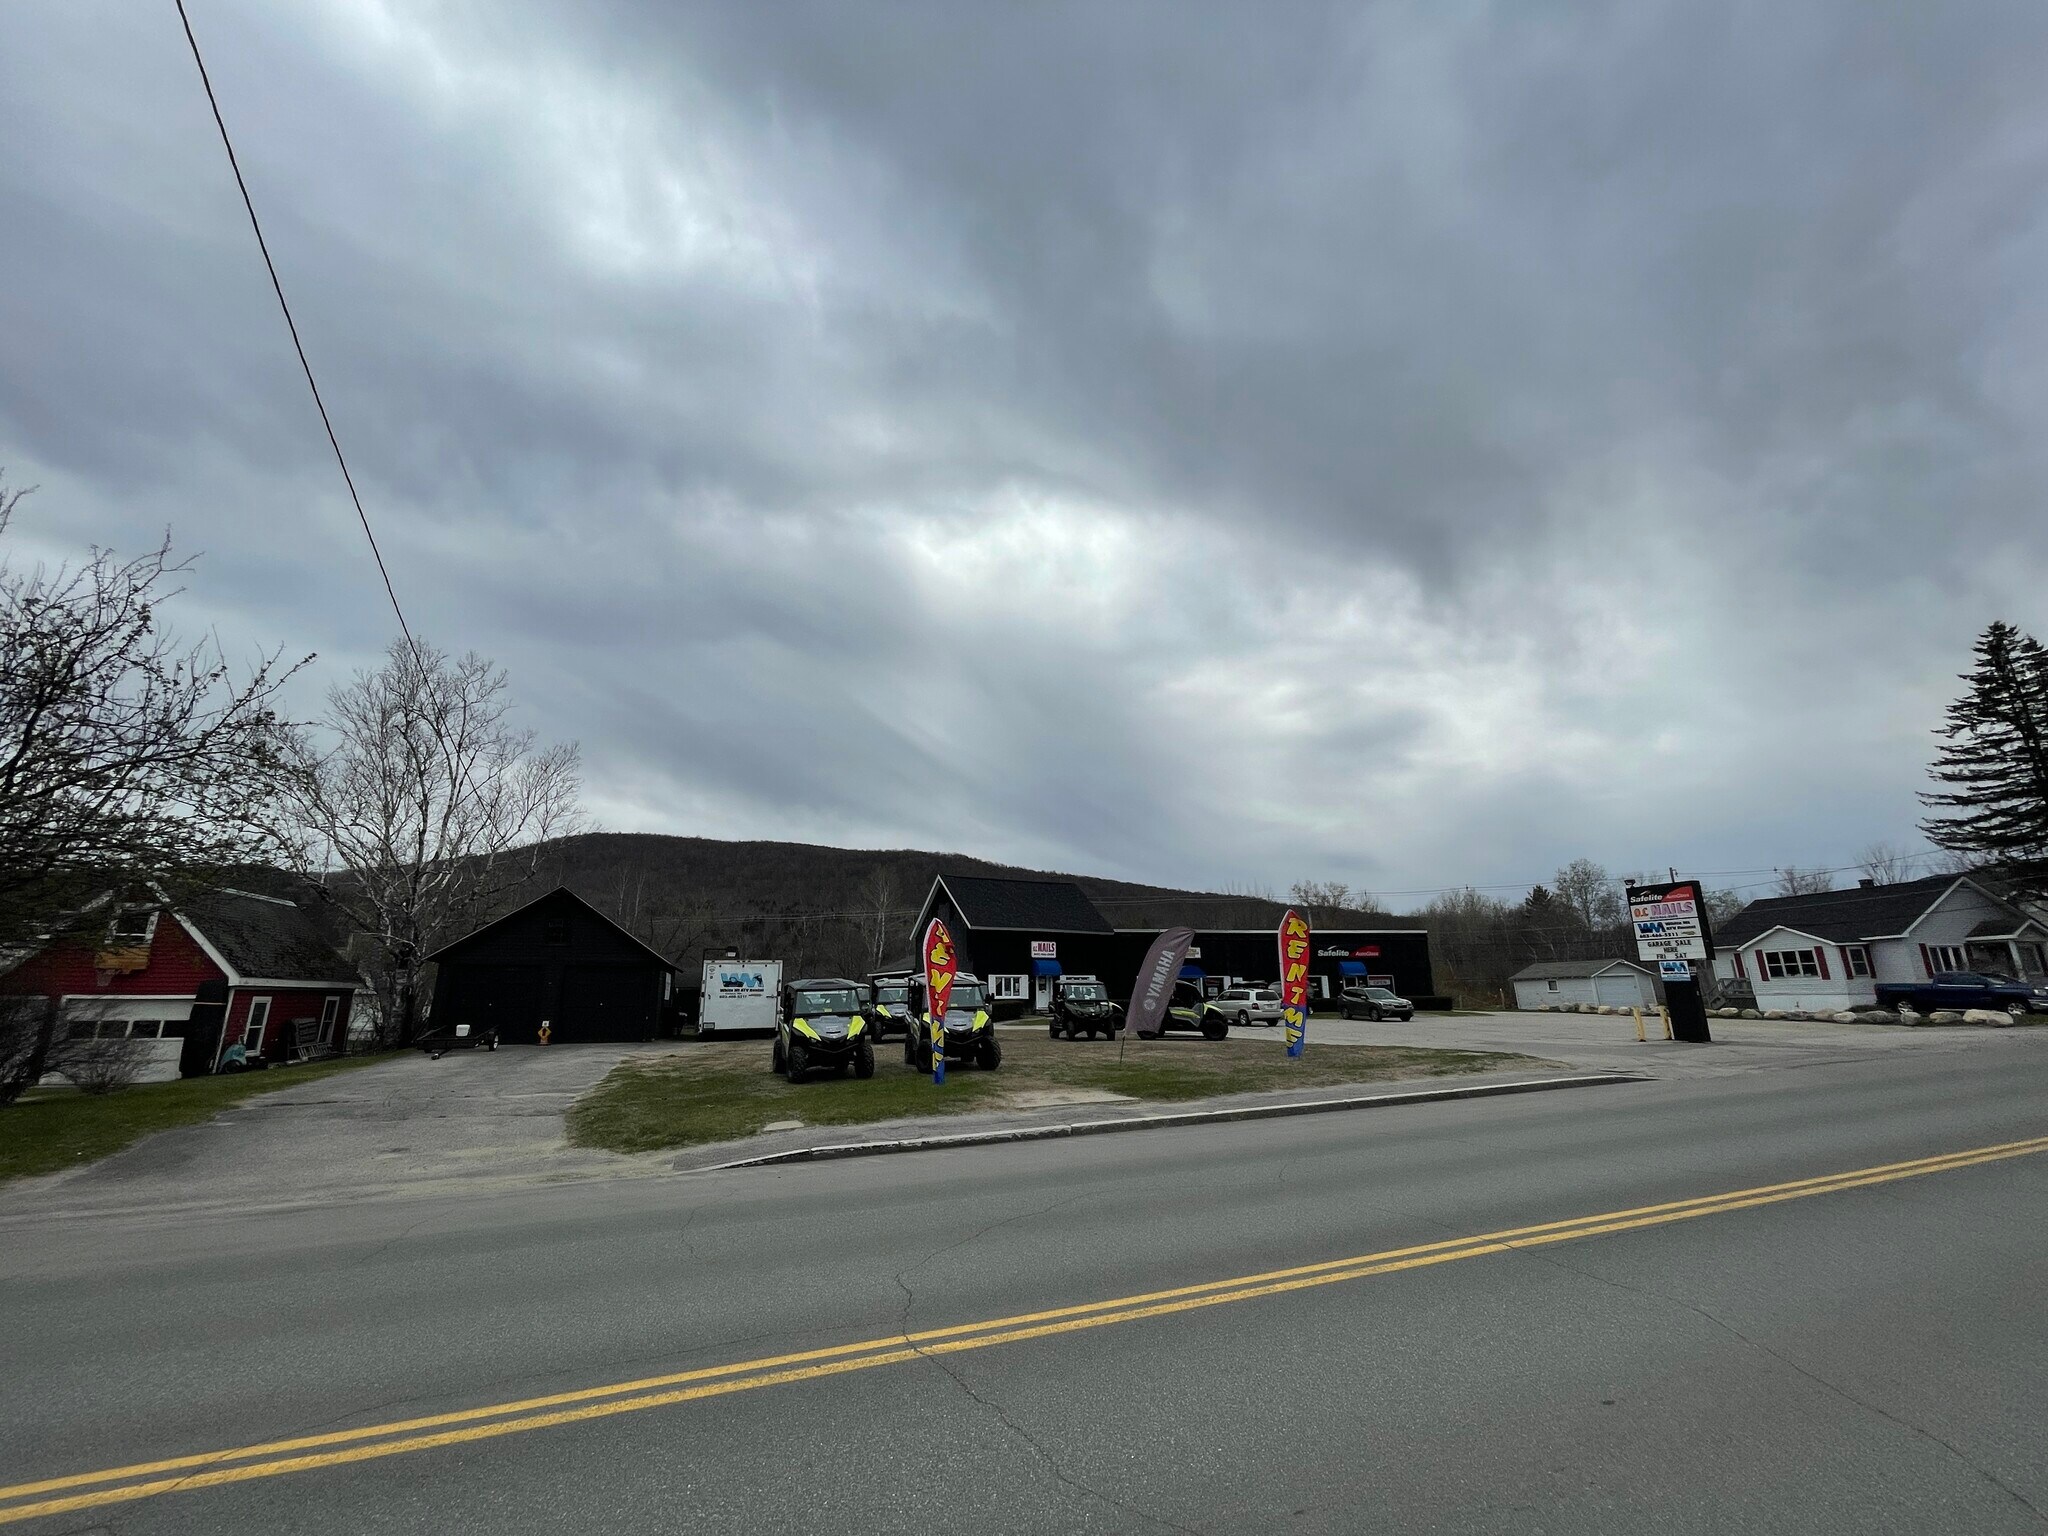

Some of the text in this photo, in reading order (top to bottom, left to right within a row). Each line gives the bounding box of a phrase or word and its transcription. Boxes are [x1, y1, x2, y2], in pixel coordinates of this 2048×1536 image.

[1630, 893, 1663, 903] Safelite
[1651, 902, 1693, 915] NAILS
[1037, 942, 1055, 952] NAILS
[1317, 949, 1350, 957] Safelite
[1146, 949, 1176, 998] YAMAHA
[1283, 917, 1308, 1048] RENT ME
